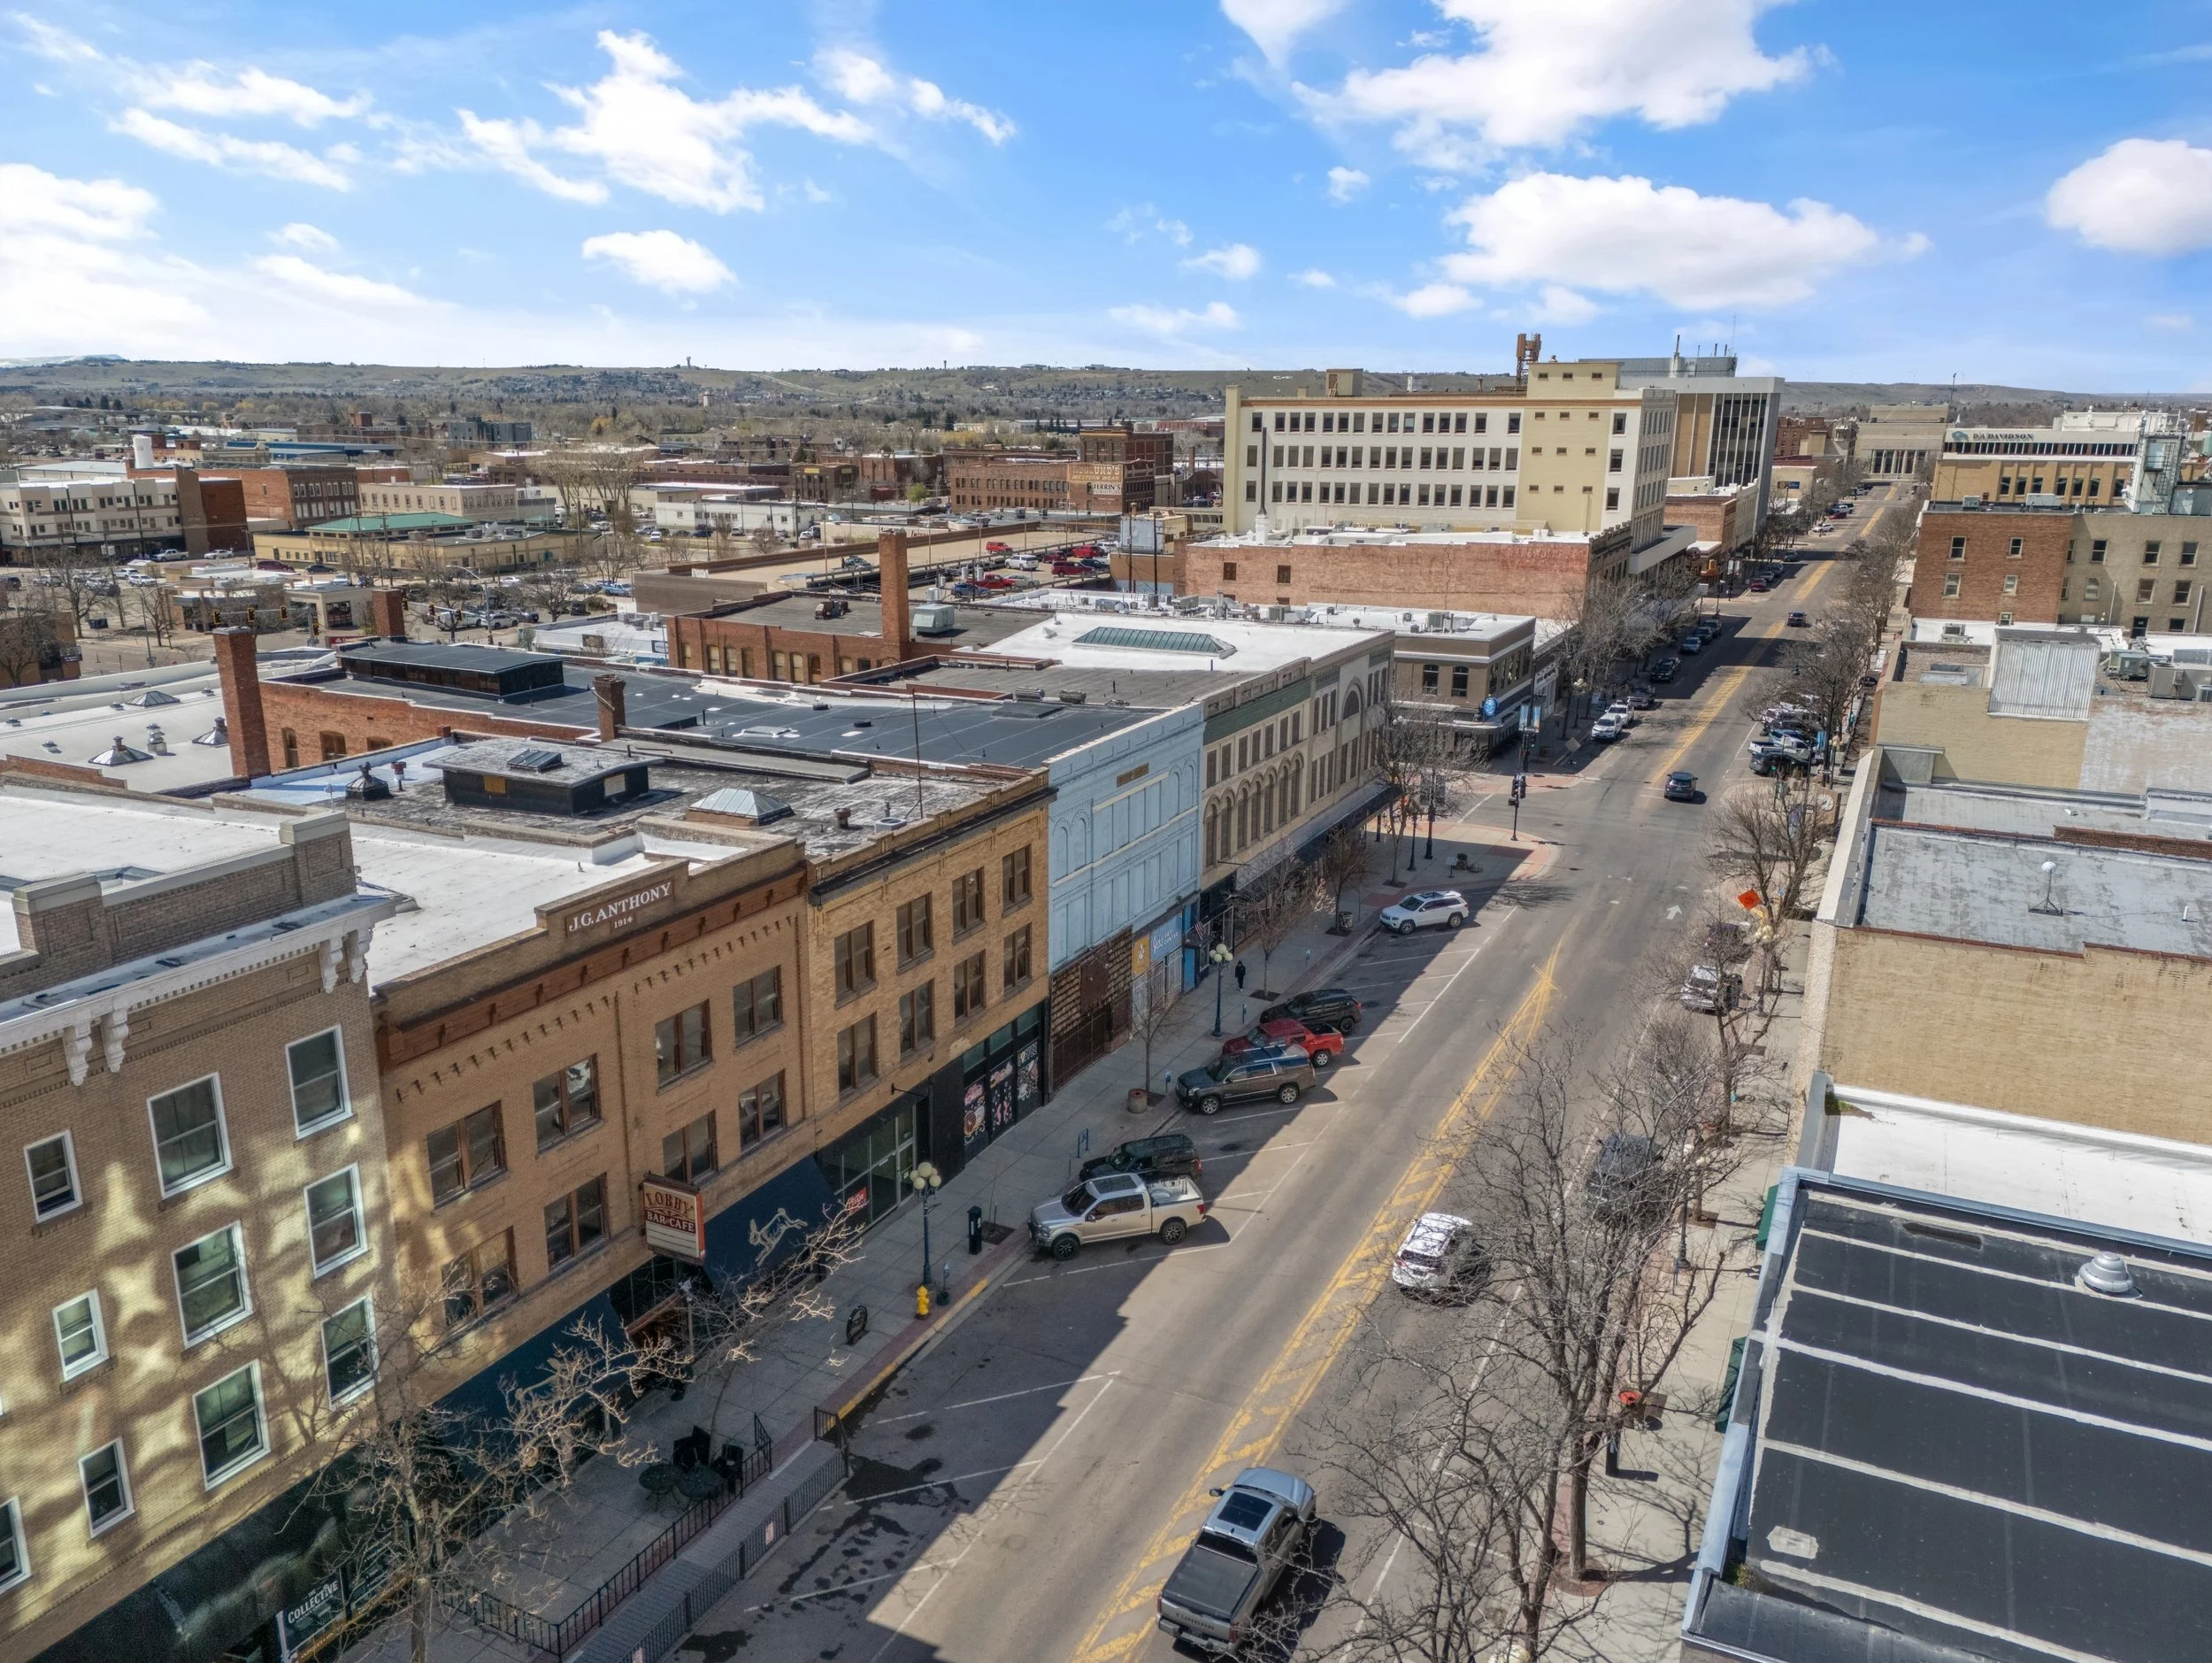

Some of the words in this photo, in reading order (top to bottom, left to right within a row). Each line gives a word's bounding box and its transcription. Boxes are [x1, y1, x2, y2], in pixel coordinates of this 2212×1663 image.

[568, 912, 594, 932] J.G.
[595, 882, 672, 923] ANTHONY
[614, 916, 634, 929] 1914
[645, 1191, 694, 1215] LOBBY
[647, 1211, 665, 1225] BAR
[669, 1218, 695, 1232] CAFE
[288, 1580, 339, 1624] COLLECTIVE
